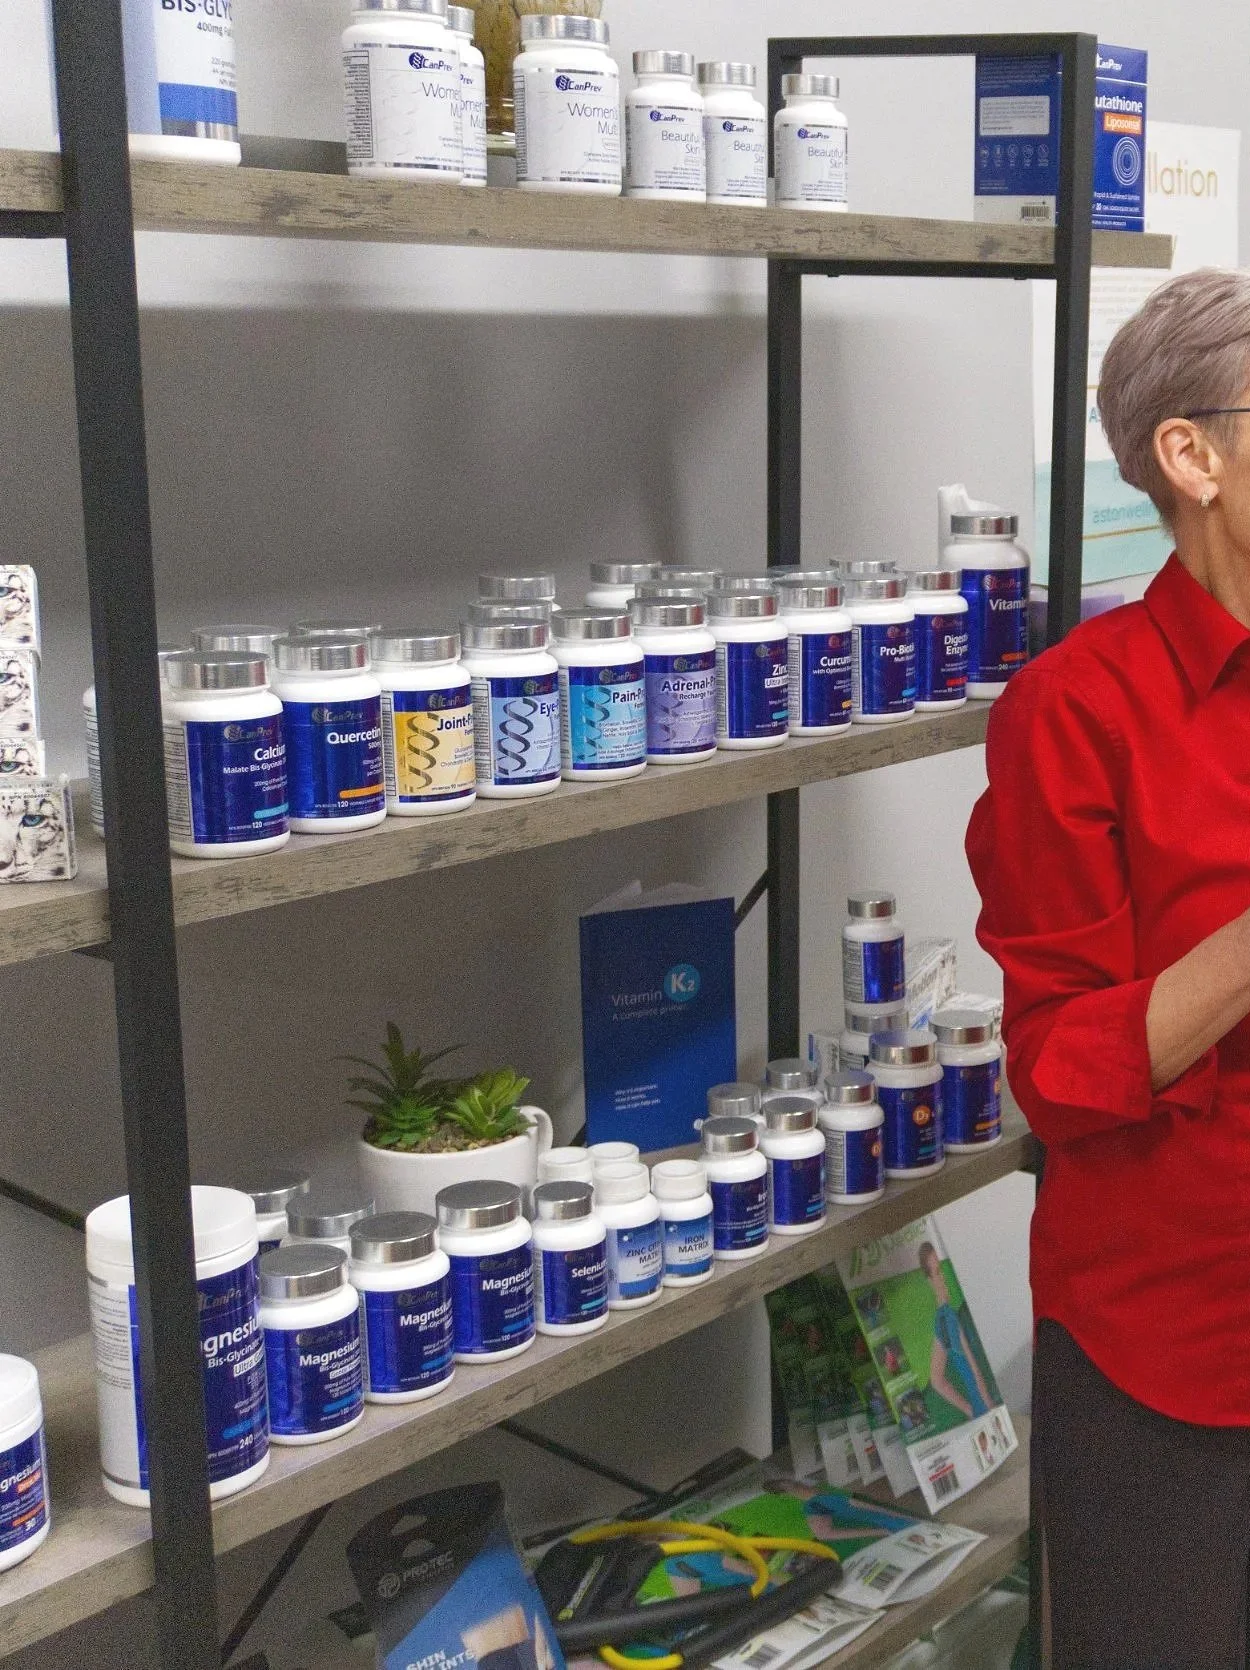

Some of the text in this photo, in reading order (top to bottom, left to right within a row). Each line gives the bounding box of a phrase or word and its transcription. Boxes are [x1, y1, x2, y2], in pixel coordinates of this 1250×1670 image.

[197, 21, 223, 37] 400mg
[423, 58, 453, 72] CanPrev
[568, 80, 602, 92] CanPrev
[1095, 95, 1143, 113] utathione
[1105, 115, 1140, 131] Liposomal
[1147, 151, 1218, 198] llation
[1093, 501, 1154, 525] astonwell
[223, 766, 249, 774] Malate
[337, 800, 349, 808] 120
[252, 821, 262, 829] 120
[611, 990, 662, 1007] Vitamin
[678, 1241, 709, 1253] MATRIX
[684, 1234, 705, 1244] IRON
[627, 1247, 646, 1257] ZINC
[204, 1315, 260, 1358] gnesiu
[300, 1336, 360, 1367] Magnesium
[240, 1433, 254, 1449] 240
[0, 1458, 41, 1493] gnesium
[439, 1651, 475, 1670] INTS
